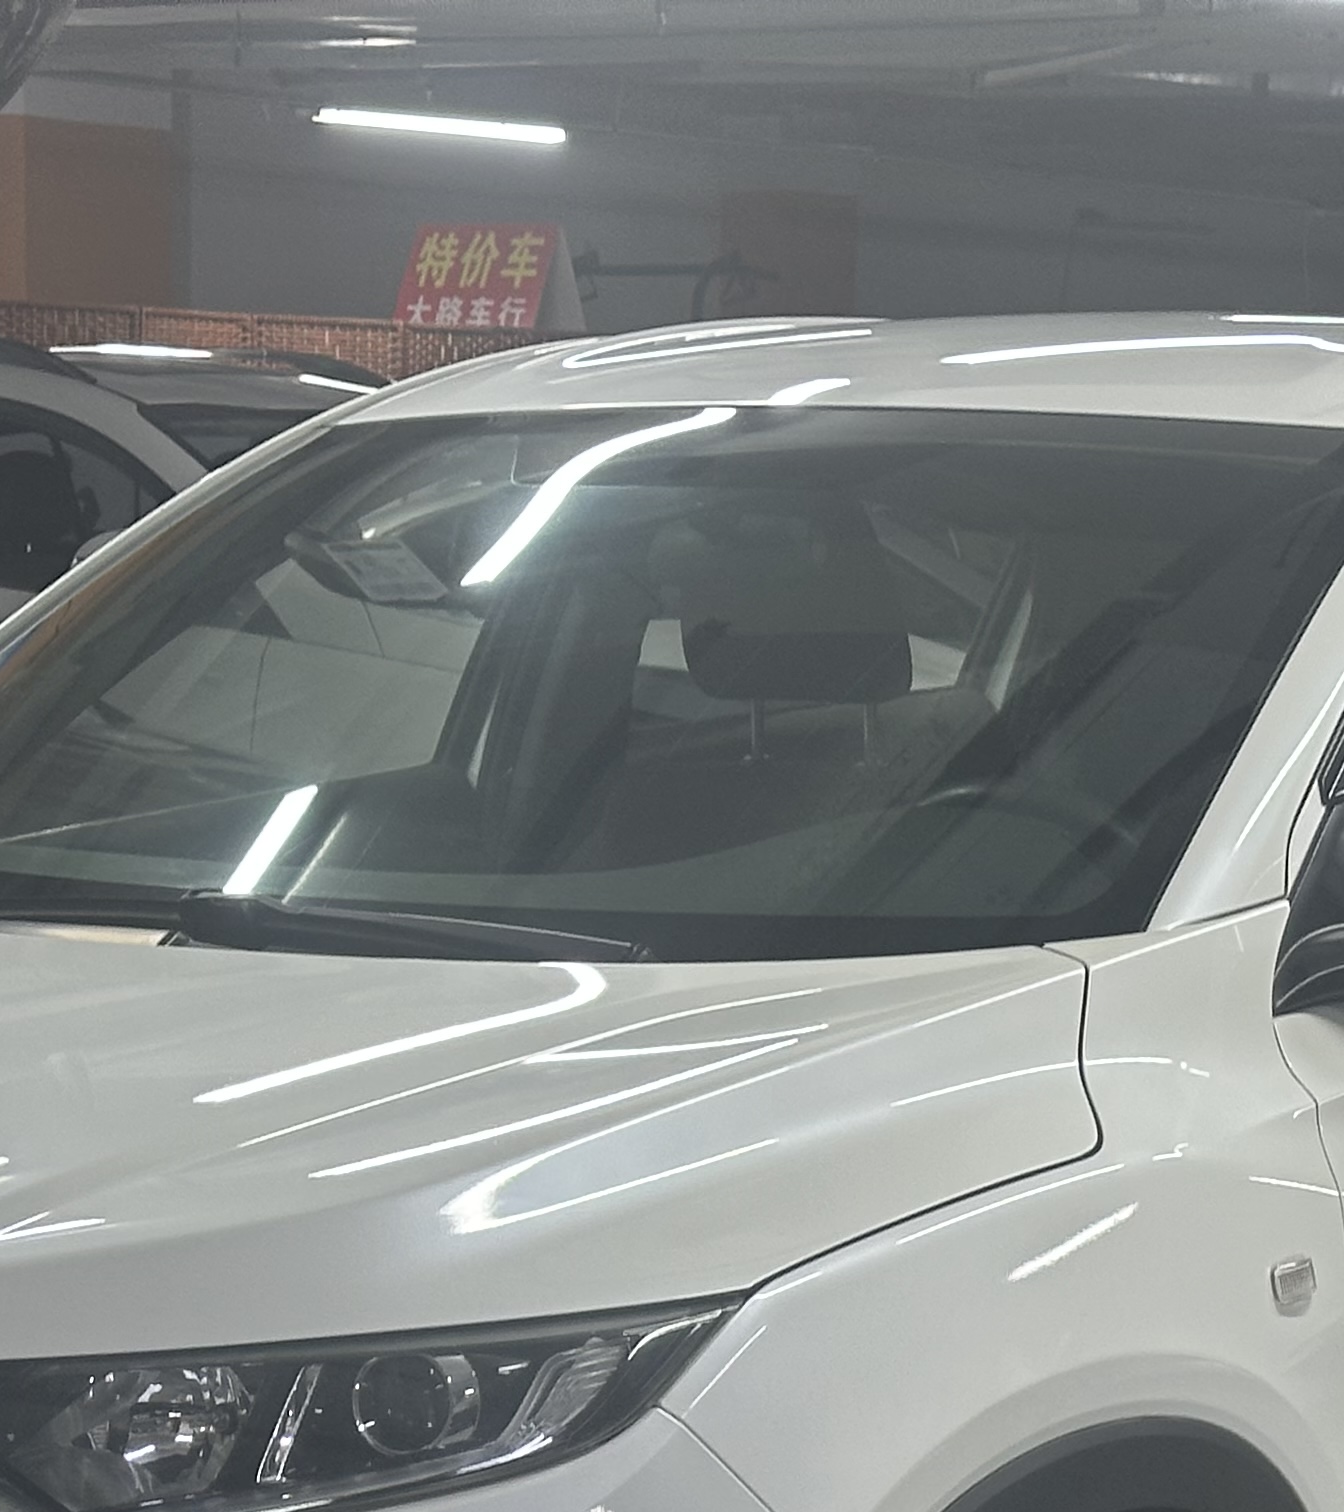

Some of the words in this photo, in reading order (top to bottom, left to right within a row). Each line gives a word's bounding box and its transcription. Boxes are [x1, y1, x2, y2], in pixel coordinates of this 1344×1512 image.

[415, 229, 546, 289] 特价车
[406, 294, 527, 328] 大路车行
